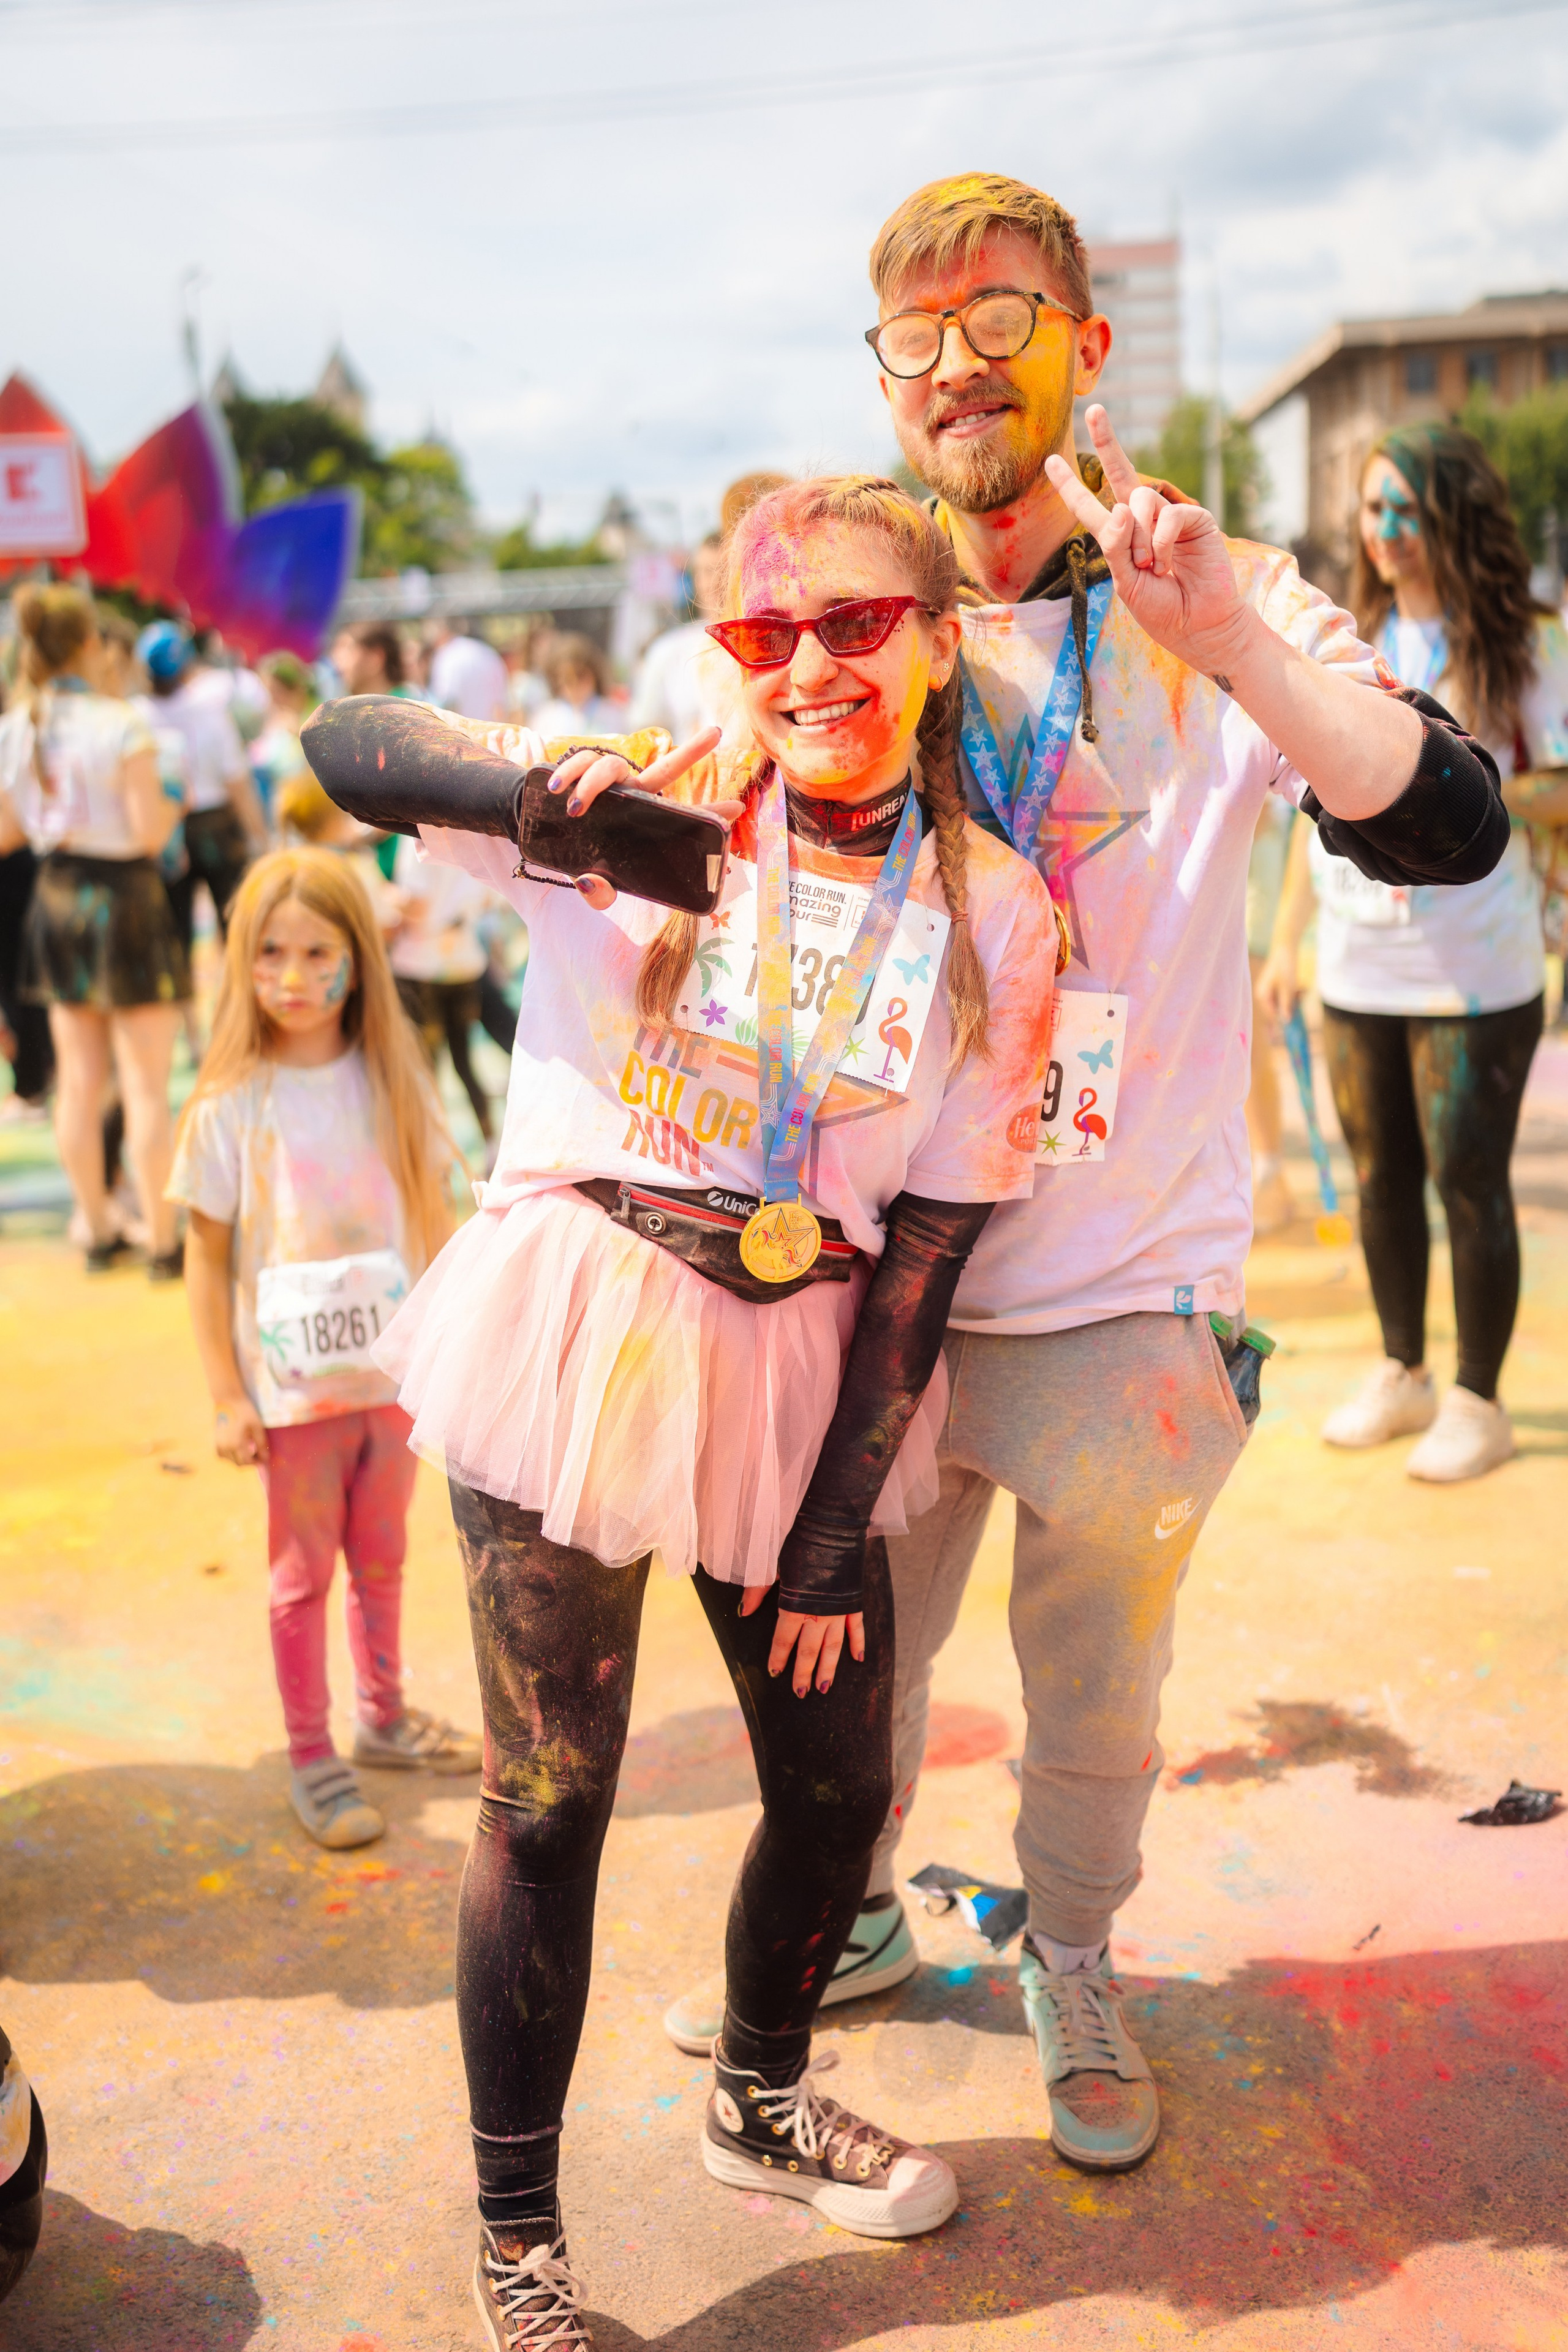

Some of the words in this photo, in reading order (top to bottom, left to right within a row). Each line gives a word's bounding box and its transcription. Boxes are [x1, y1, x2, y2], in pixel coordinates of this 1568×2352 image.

[907, 810, 916, 831] RUN
[898, 827, 915, 857] COLOR
[892, 854, 907, 872] THE
[767, 868, 780, 883] THE
[796, 883, 826, 899] COLOR
[768, 1028, 782, 1061] COLOR
[769, 1062, 783, 1083] RUN
[802, 1072, 822, 1095] RUN
[619, 1050, 760, 1150] COLOR
[790, 1093, 812, 1125] COLOR
[785, 1124, 801, 1143] THE
[300, 1304, 380, 1355] 18261
[1161, 1497, 1193, 1526] NIKE
